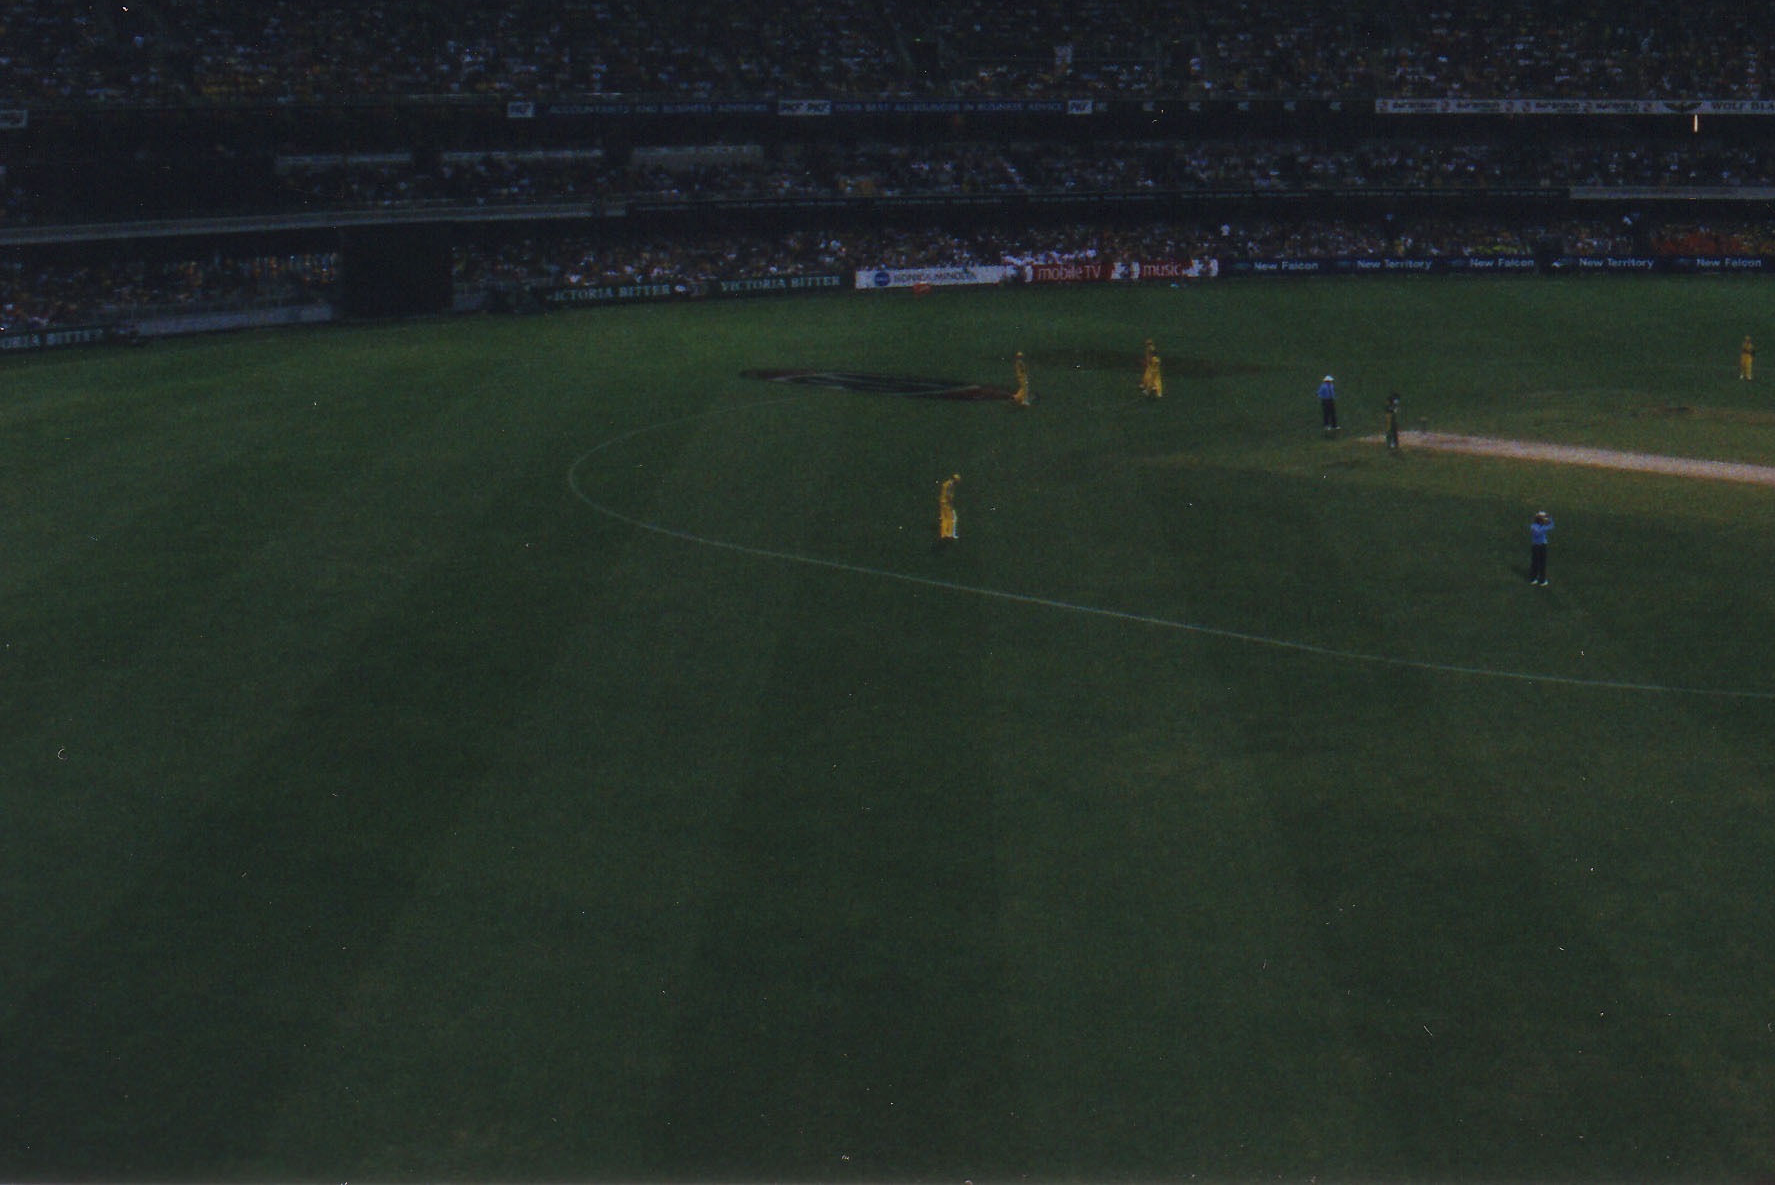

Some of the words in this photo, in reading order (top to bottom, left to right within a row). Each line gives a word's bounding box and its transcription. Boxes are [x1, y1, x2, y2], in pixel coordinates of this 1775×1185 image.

[1254, 262, 1277, 270] New
[1281, 261, 1319, 270] Falcon
[1357, 260, 1381, 269] New
[1384, 259, 1432, 270] Territory
[1470, 259, 1493, 267] New
[1498, 258, 1535, 267] Falcon
[1579, 258, 1603, 267] New
[1607, 257, 1654, 269] Territory
[1697, 258, 1721, 267] New
[1725, 257, 1762, 267] Falcon
[1038, 264, 1083, 280] mobile
[1085, 265, 1102, 278] TV
[1143, 262, 1182, 276] music
[720, 279, 786, 292] VICTORIA
[791, 276, 840, 289] BITTER
[618, 284, 670, 298] BITTER
